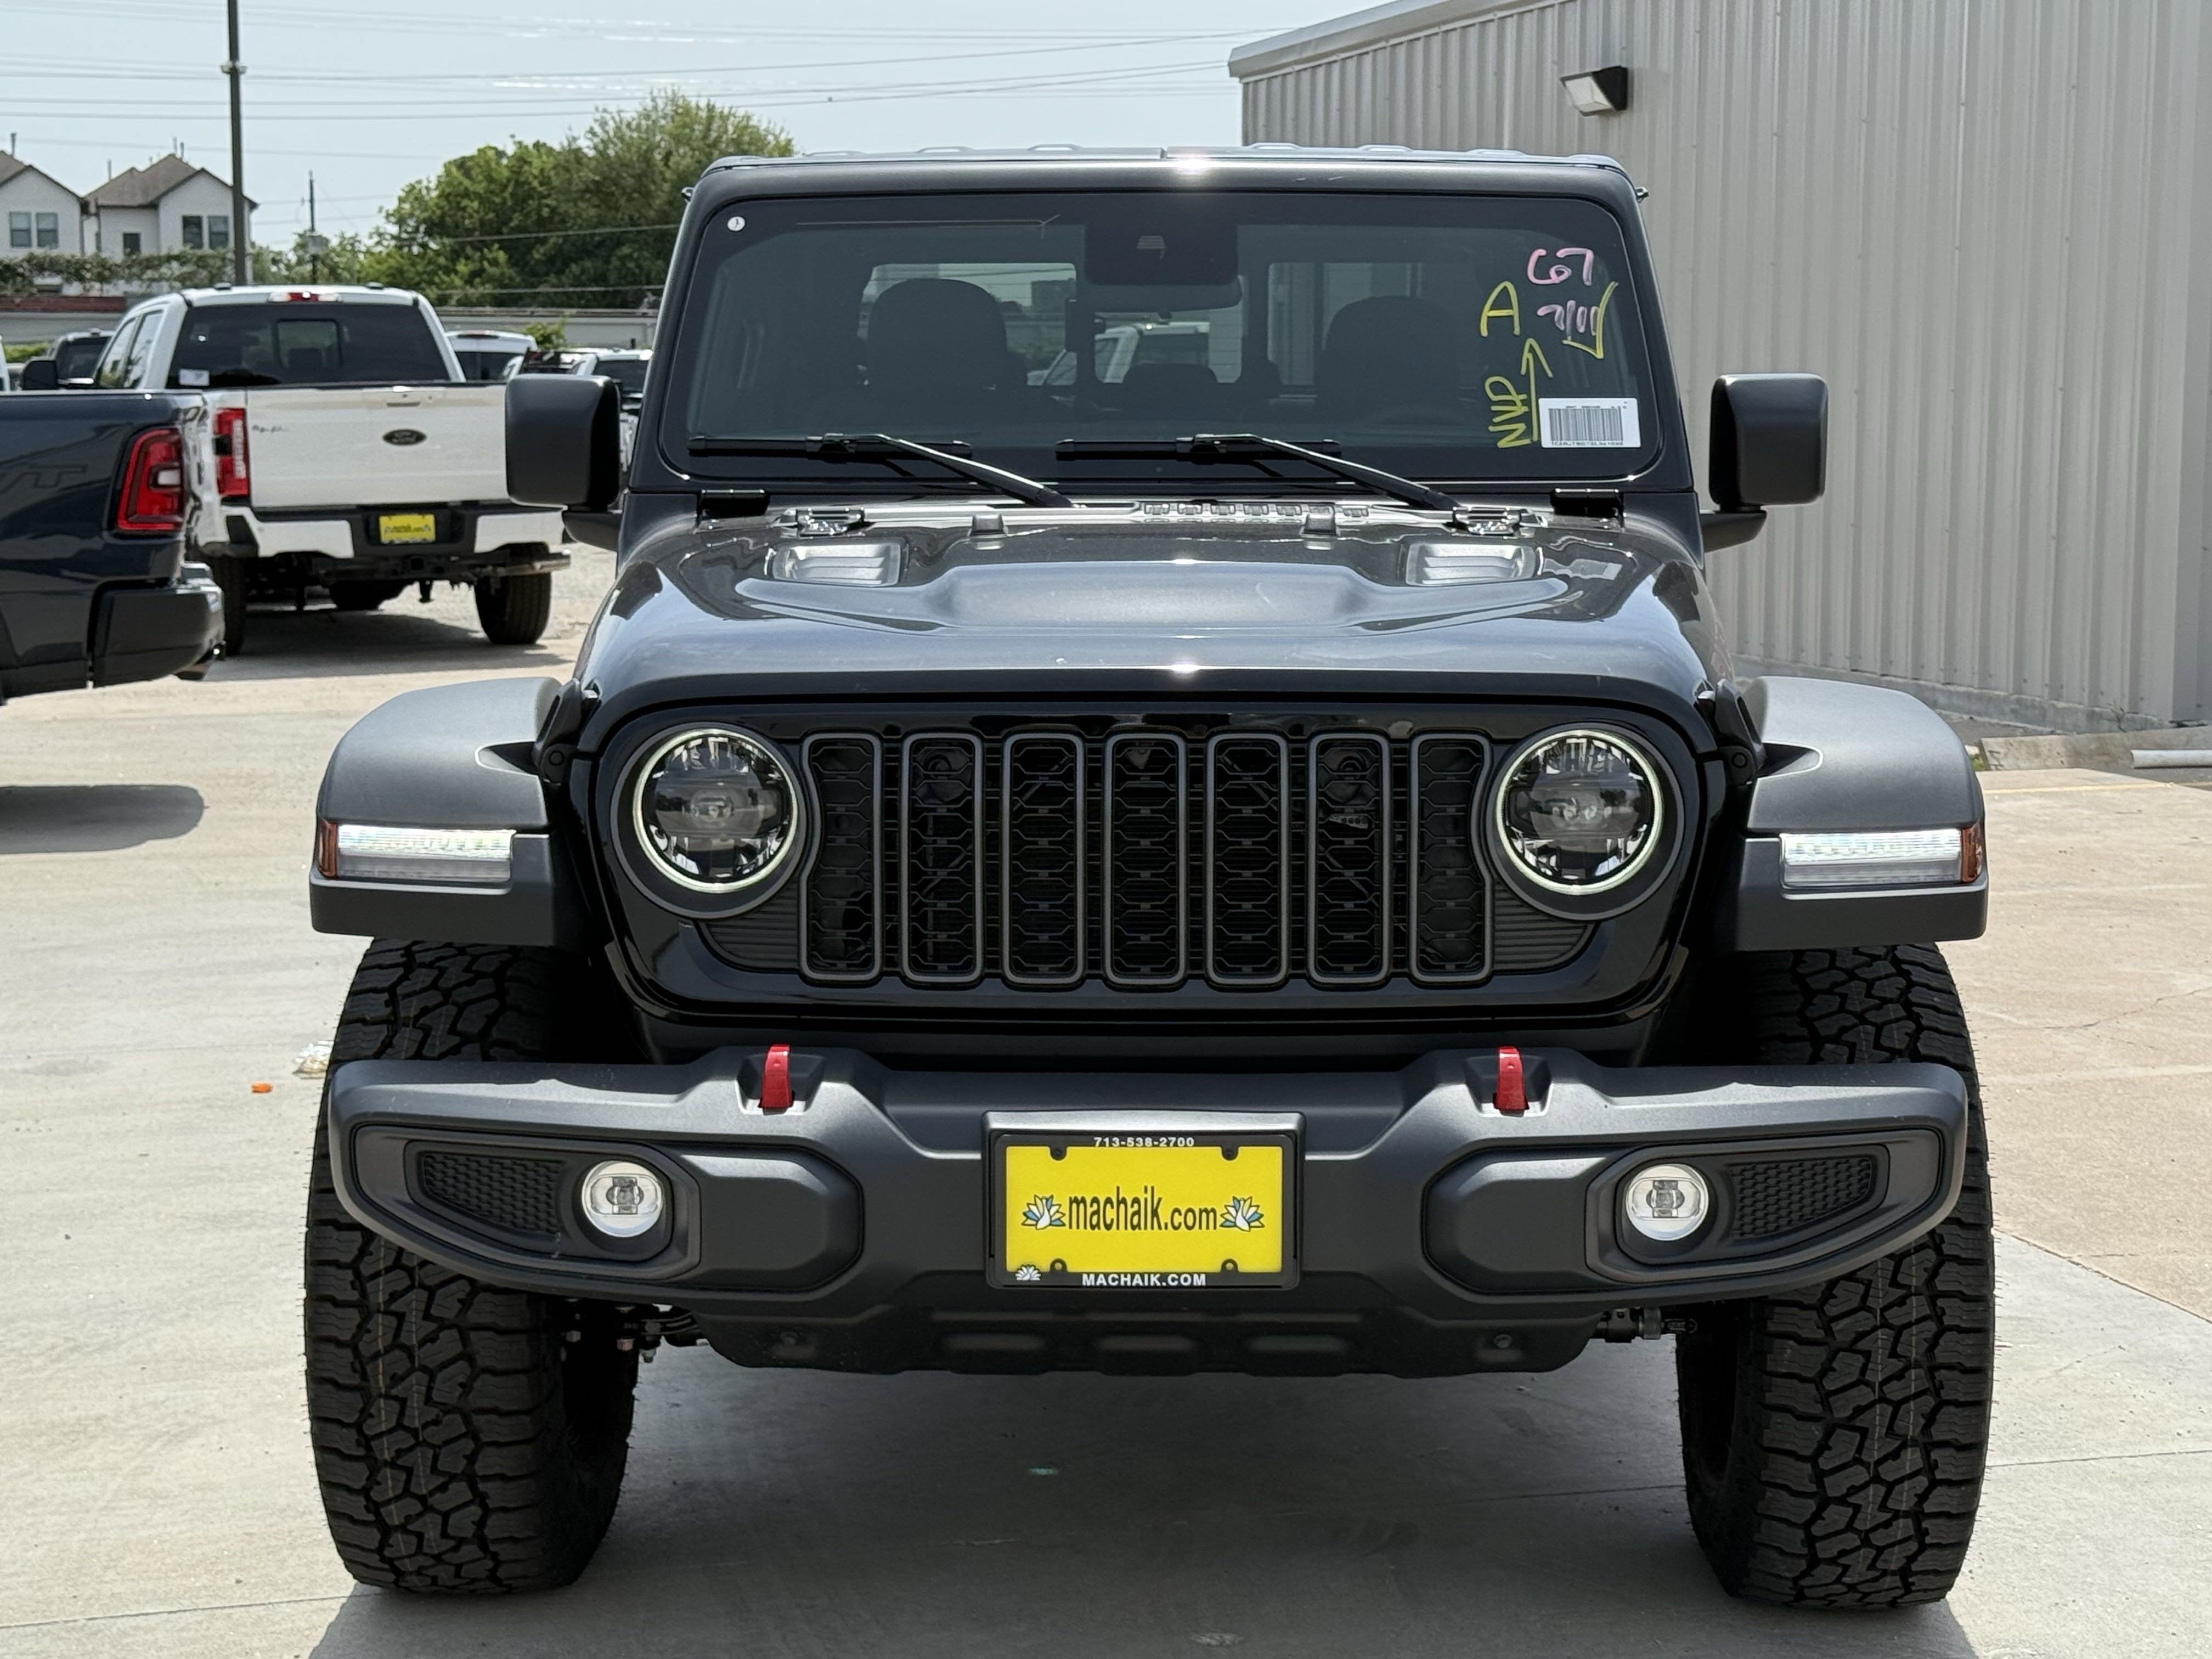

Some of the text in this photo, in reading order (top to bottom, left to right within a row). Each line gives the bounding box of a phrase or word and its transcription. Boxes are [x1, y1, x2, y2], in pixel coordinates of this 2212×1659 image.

[1480, 281, 1520, 337] A
[1093, 1137, 1194, 1147] 713-538-2700
[1068, 1186, 1217, 1231] machaik.com
[1082, 1273, 1206, 1286] MACHAIK.COM
